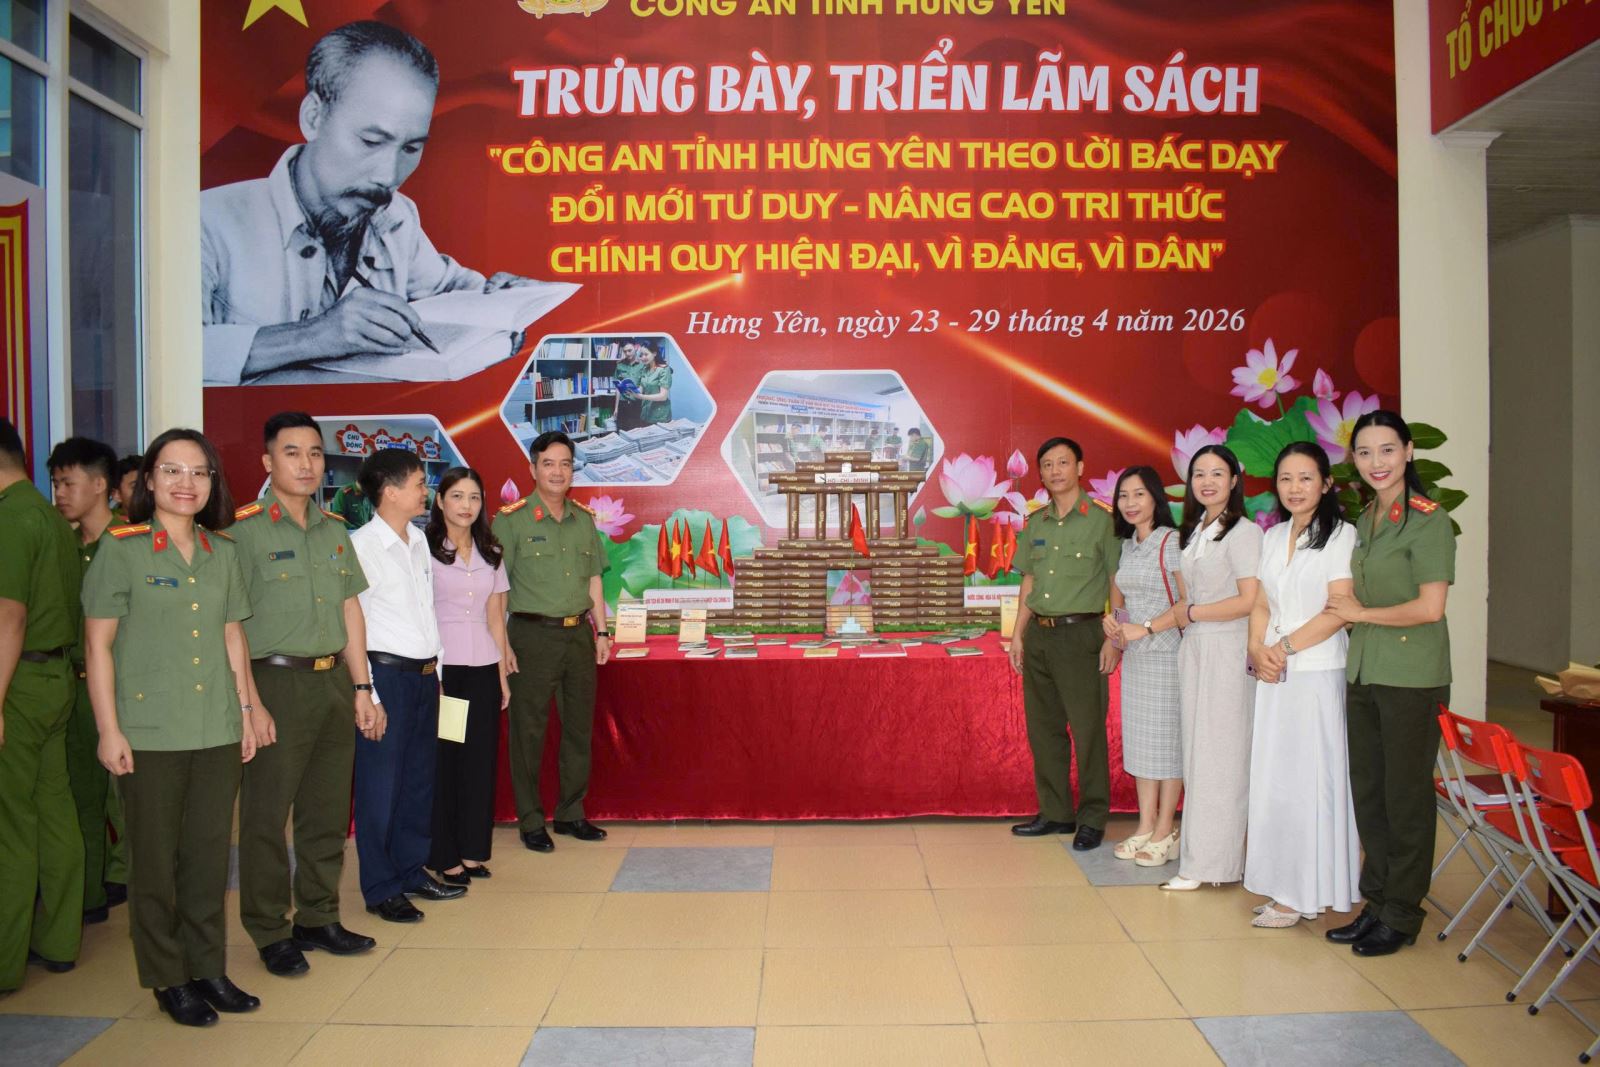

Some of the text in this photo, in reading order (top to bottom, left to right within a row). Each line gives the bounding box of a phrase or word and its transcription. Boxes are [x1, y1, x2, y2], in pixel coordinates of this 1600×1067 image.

[513, 37, 1259, 120] TRƯNG BÀY, TRIỂN LÃM SÁCH
[610, 143, 664, 172] AN
[671, 135, 757, 171] TỈNH
[767, 137, 871, 170] HƯNG
[877, 135, 951, 169] YÊN
[959, 141, 1057, 169] THEO
[1065, 135, 1120, 169] LỜI
[1131, 136, 1202, 169] BÁC
[1211, 143, 1283, 177] DẠY
[550, 183, 1224, 223] ĐỔI MỚI TƯ DUY - NÂNG CAO TRI THỨC
[550, 238, 661, 273] CHÍNH
[670, 243, 748, 272] QUY
[755, 236, 840, 277] HIỆN
[848, 242, 920, 277] ĐẠI,
[926, 235, 962, 270] VÌ
[971, 234, 1083, 276] ĐẢNG,
[1089, 235, 1125, 269] VÌ
[686, 311, 764, 340] Hưng
[772, 309, 827, 337] Yên,
[836, 309, 901, 339] ngày
[907, 309, 940, 333] 23
[967, 309, 1001, 332] 29
[1008, 308, 1086, 338] tháng
[1092, 308, 1109, 331] 4
[1116, 309, 1174, 332] năm
[1182, 308, 1246, 332] 2026
